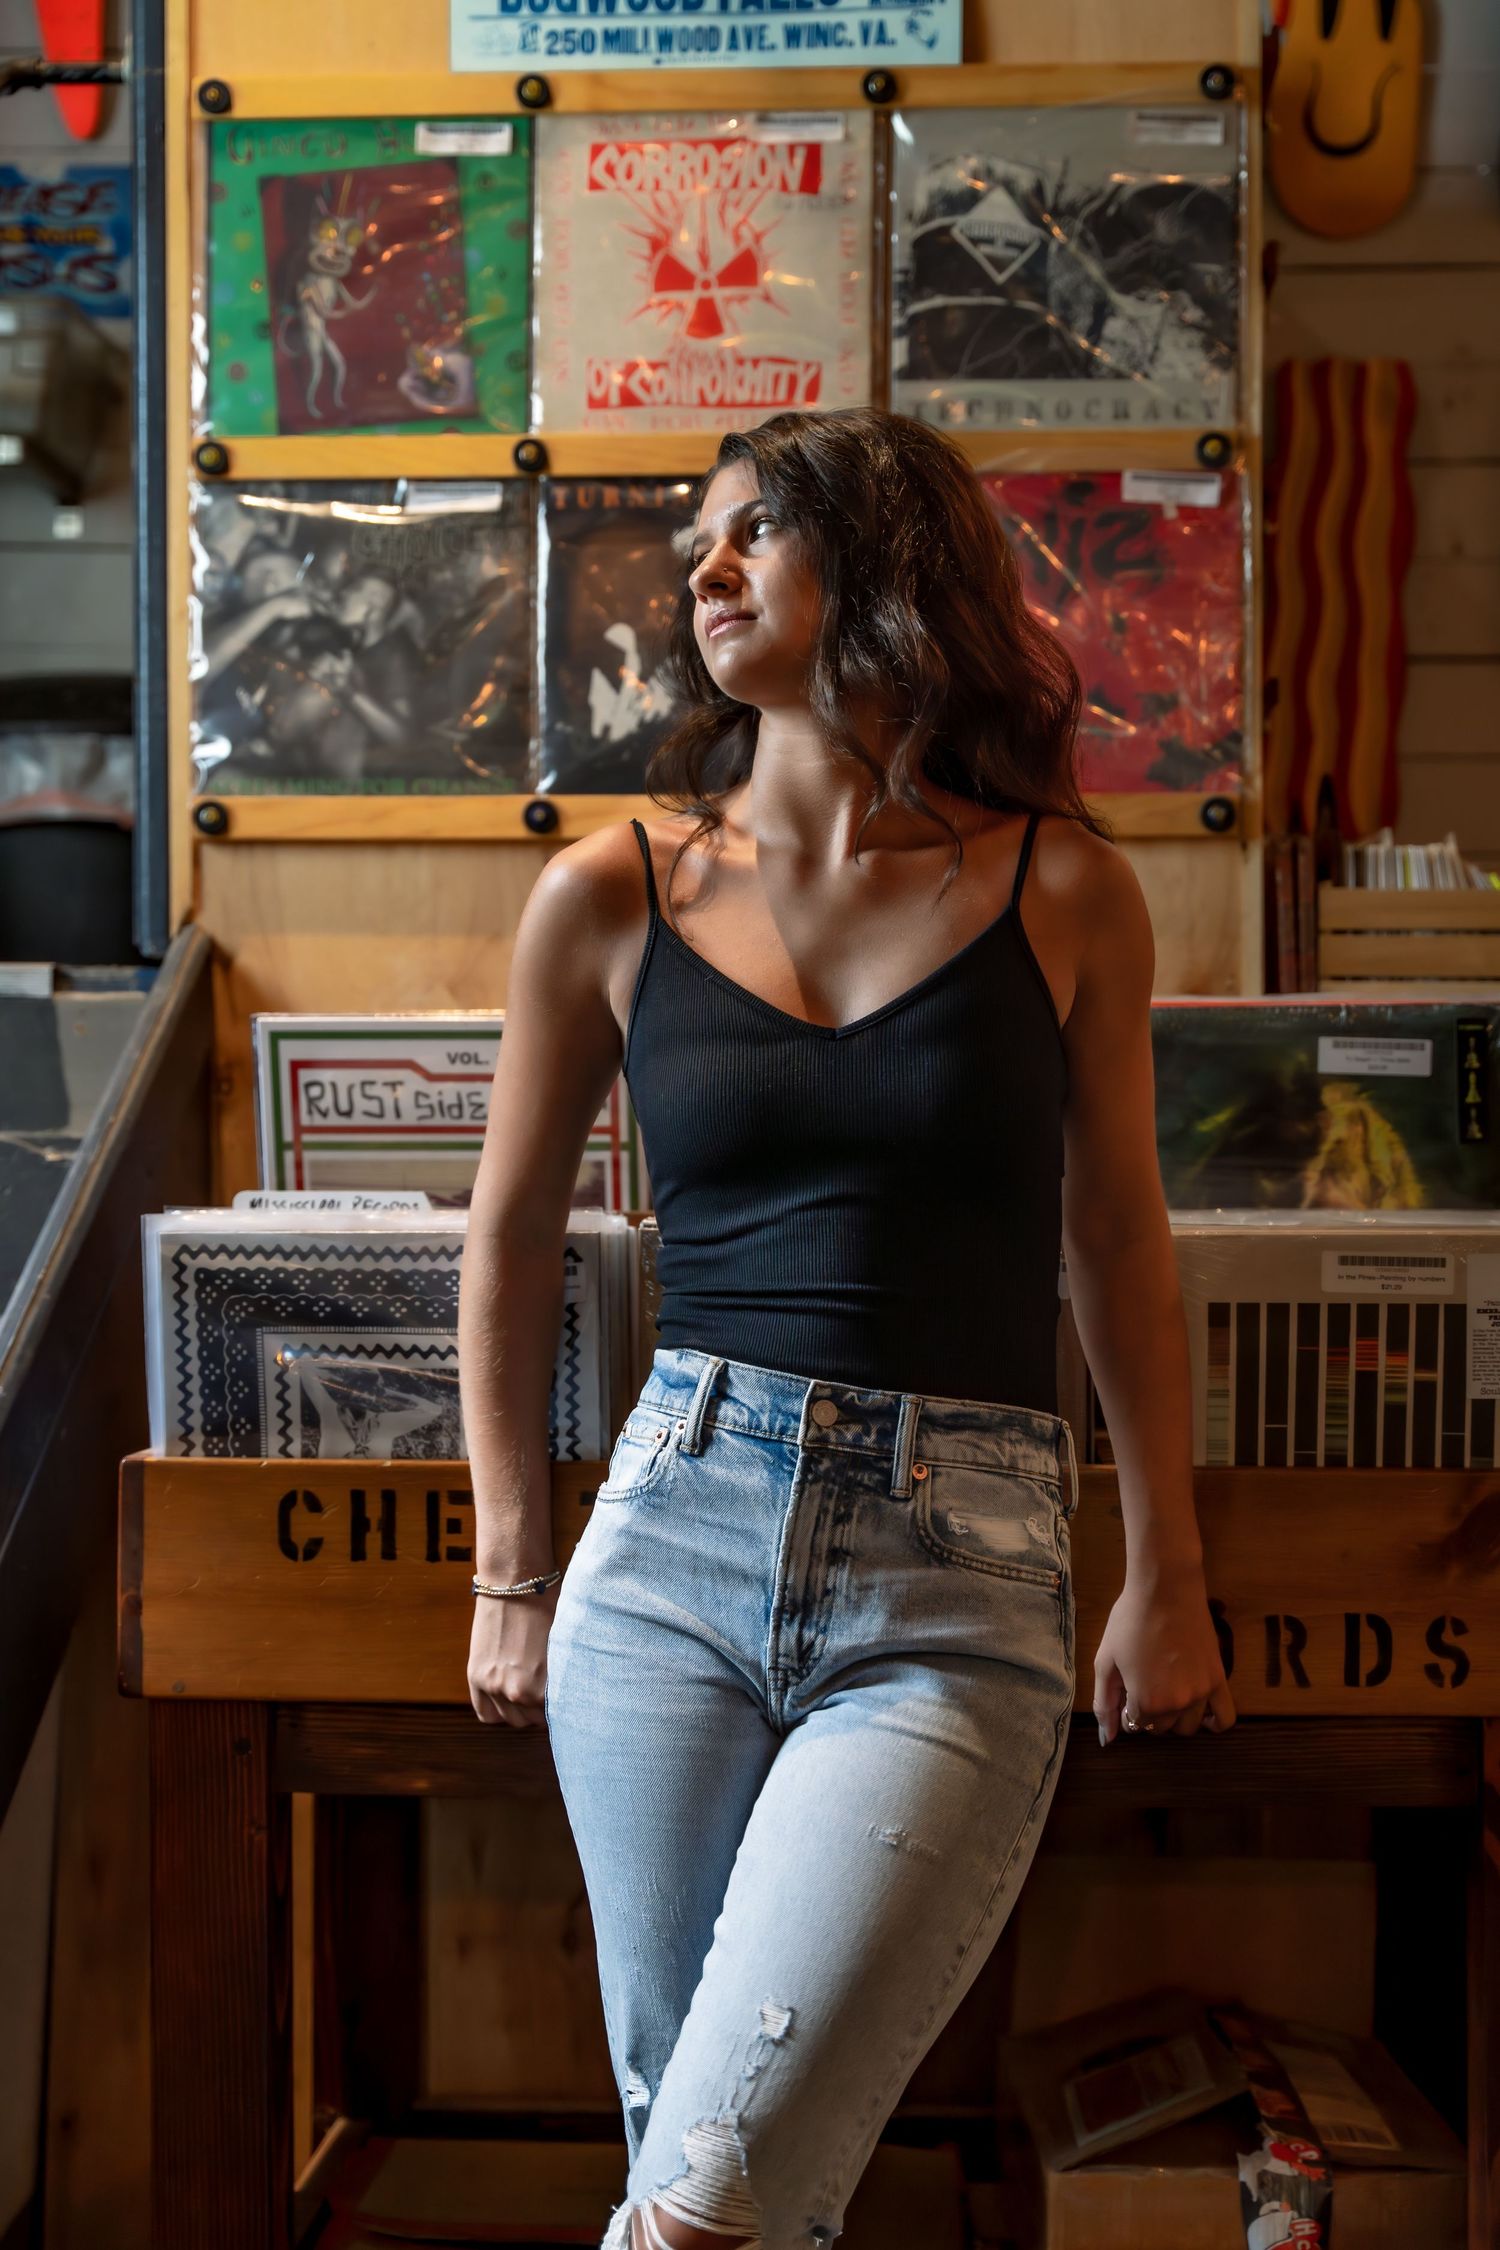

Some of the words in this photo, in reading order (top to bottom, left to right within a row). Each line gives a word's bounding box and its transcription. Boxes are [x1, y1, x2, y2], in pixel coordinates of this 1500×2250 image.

[545, 28, 597, 56] 250
[726, 23, 776, 51] AVE.
[783, 20, 854, 49] WINC.
[859, 19, 898, 46] VA.
[590, 142, 809, 192] CORROSION
[588, 358, 622, 406] OF
[445, 1051, 491, 1066] VOL.
[303, 1080, 405, 1120] RUST
[277, 1488, 475, 1563] CHE
